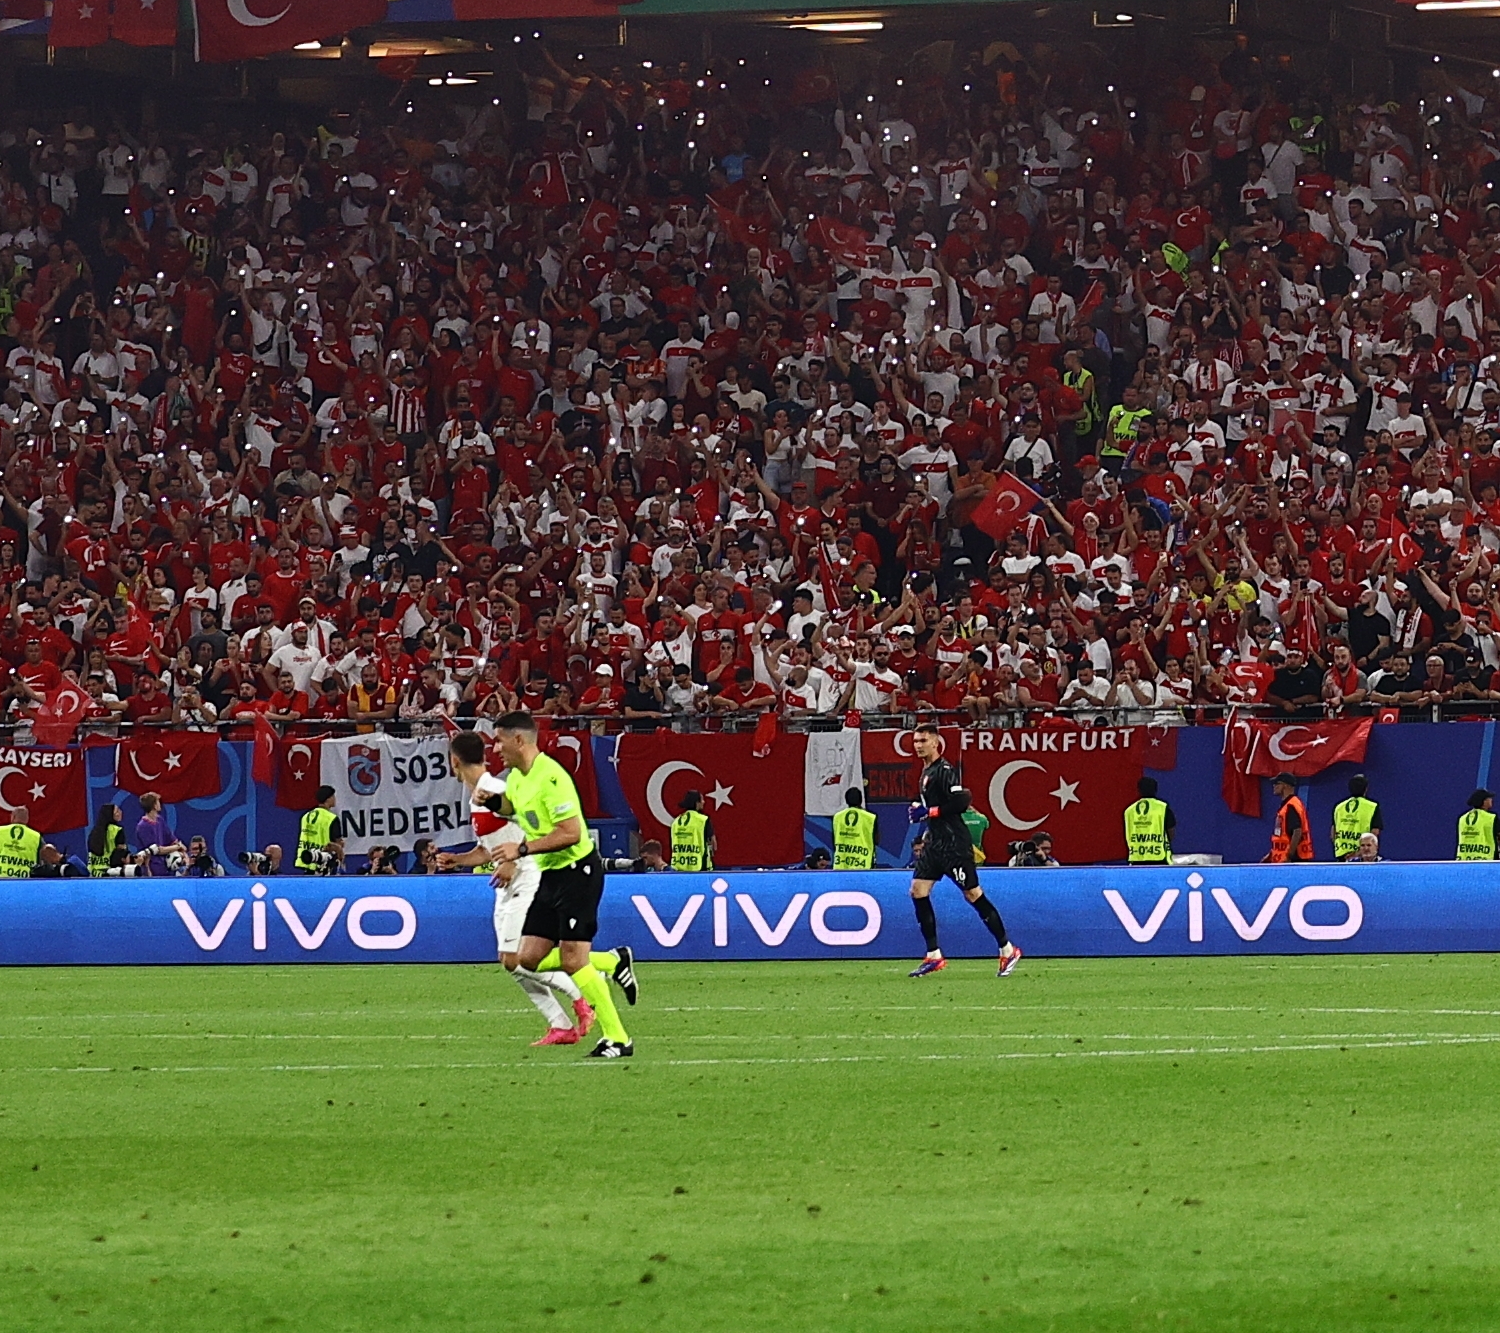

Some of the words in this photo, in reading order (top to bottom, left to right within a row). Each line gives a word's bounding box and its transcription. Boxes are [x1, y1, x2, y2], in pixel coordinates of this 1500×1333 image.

[961, 727, 1133, 753] FRANKFURT
[342, 801, 469, 838] NEDERL
[952, 865, 967, 883] 16
[172, 883, 418, 950] vivo
[631, 878, 882, 947] vivo
[1103, 872, 1364, 942] vivo
